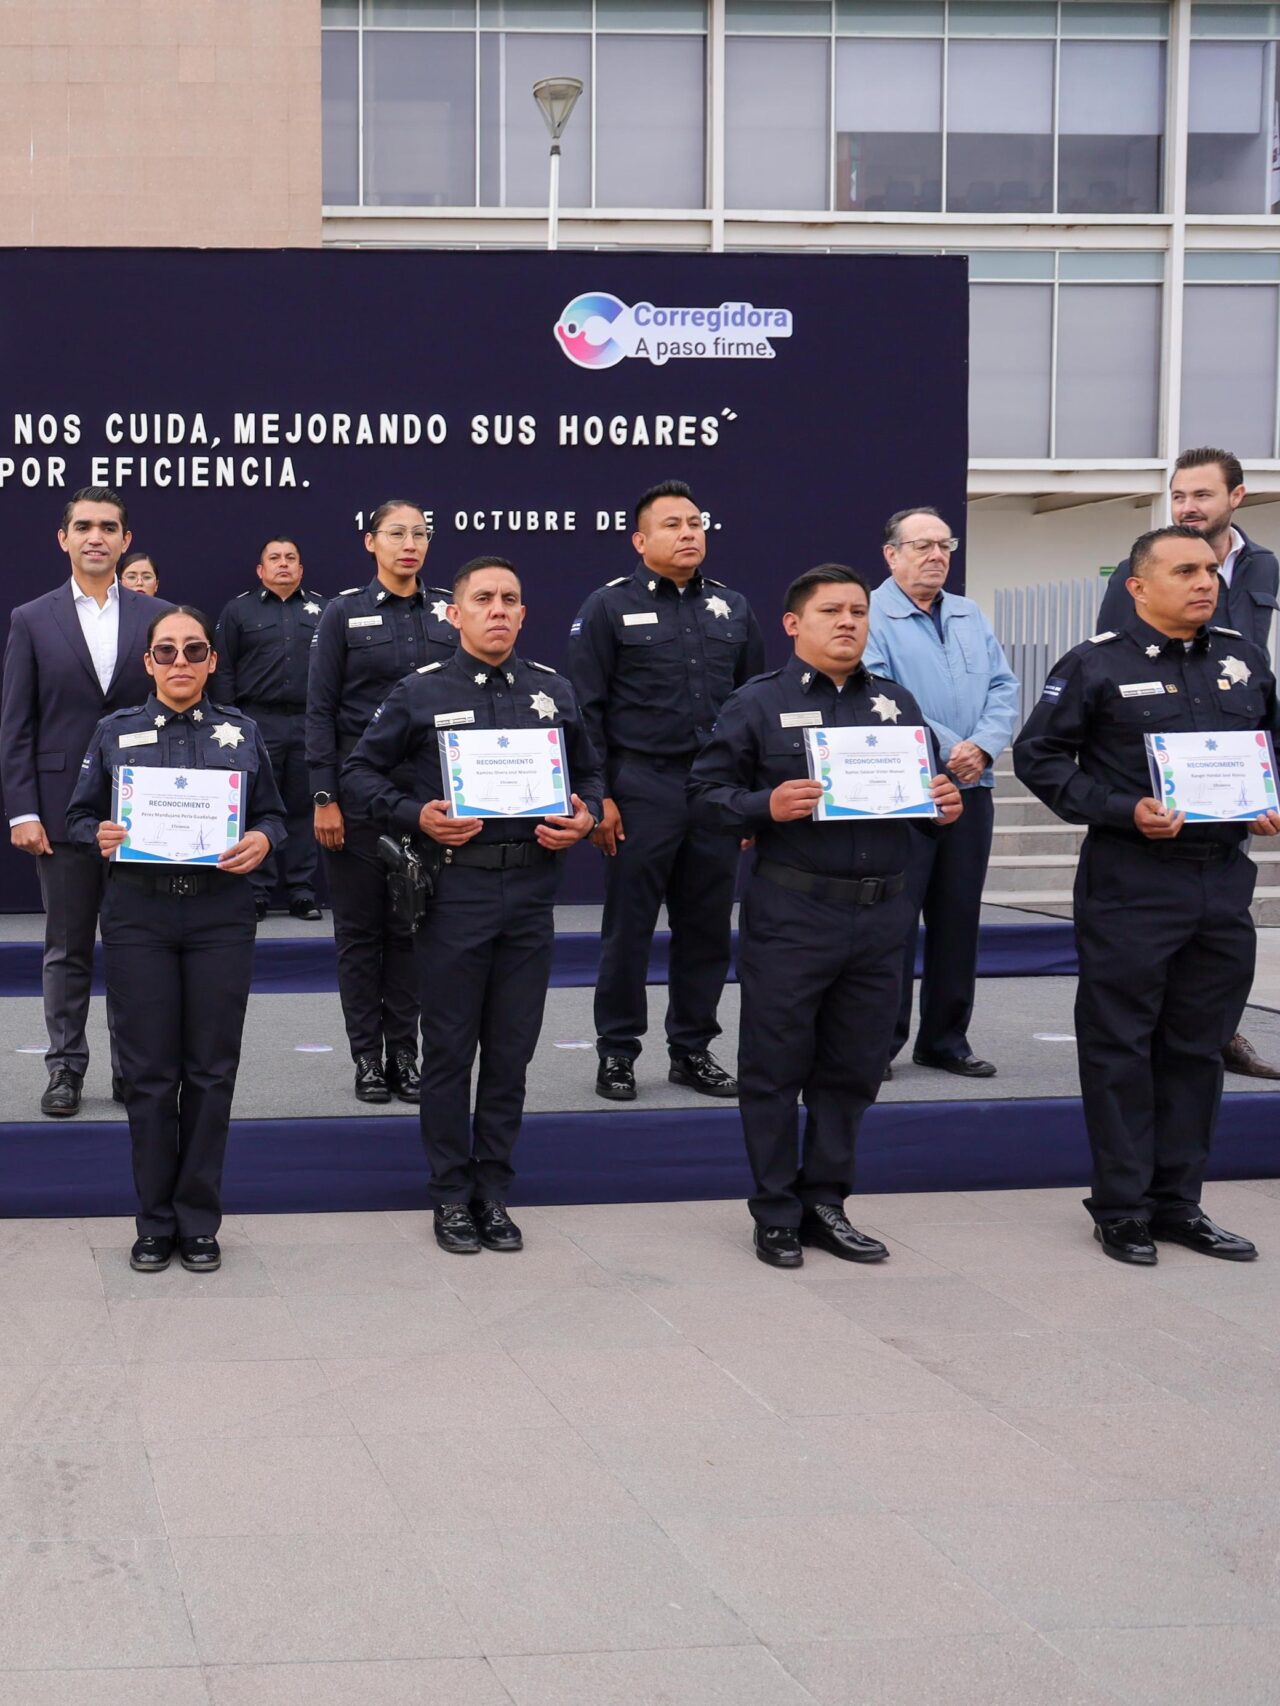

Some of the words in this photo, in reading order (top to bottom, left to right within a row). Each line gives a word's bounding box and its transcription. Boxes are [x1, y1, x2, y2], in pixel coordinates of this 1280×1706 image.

[634, 304, 788, 333] Corregidora
[634, 337, 650, 355] A
[656, 341, 707, 360] paso
[713, 336, 773, 356] firme.
[14, 414, 81, 444] NOS
[105, 413, 220, 449] CUIDA,
[234, 413, 447, 445] MEJORANDO
[472, 414, 536, 445] SUS
[91, 456, 310, 488] EFICIENCIA.
[455, 510, 576, 531] OCTUBRE
[596, 510, 627, 531] DE
[476, 758, 534, 766] RECONOCIMIENTO
[844, 757, 902, 765] RECONOCIMIENTO
[1187, 761, 1245, 769] RECONOCIMIENTO
[148, 799, 210, 809] RECONOCIMIENTO
